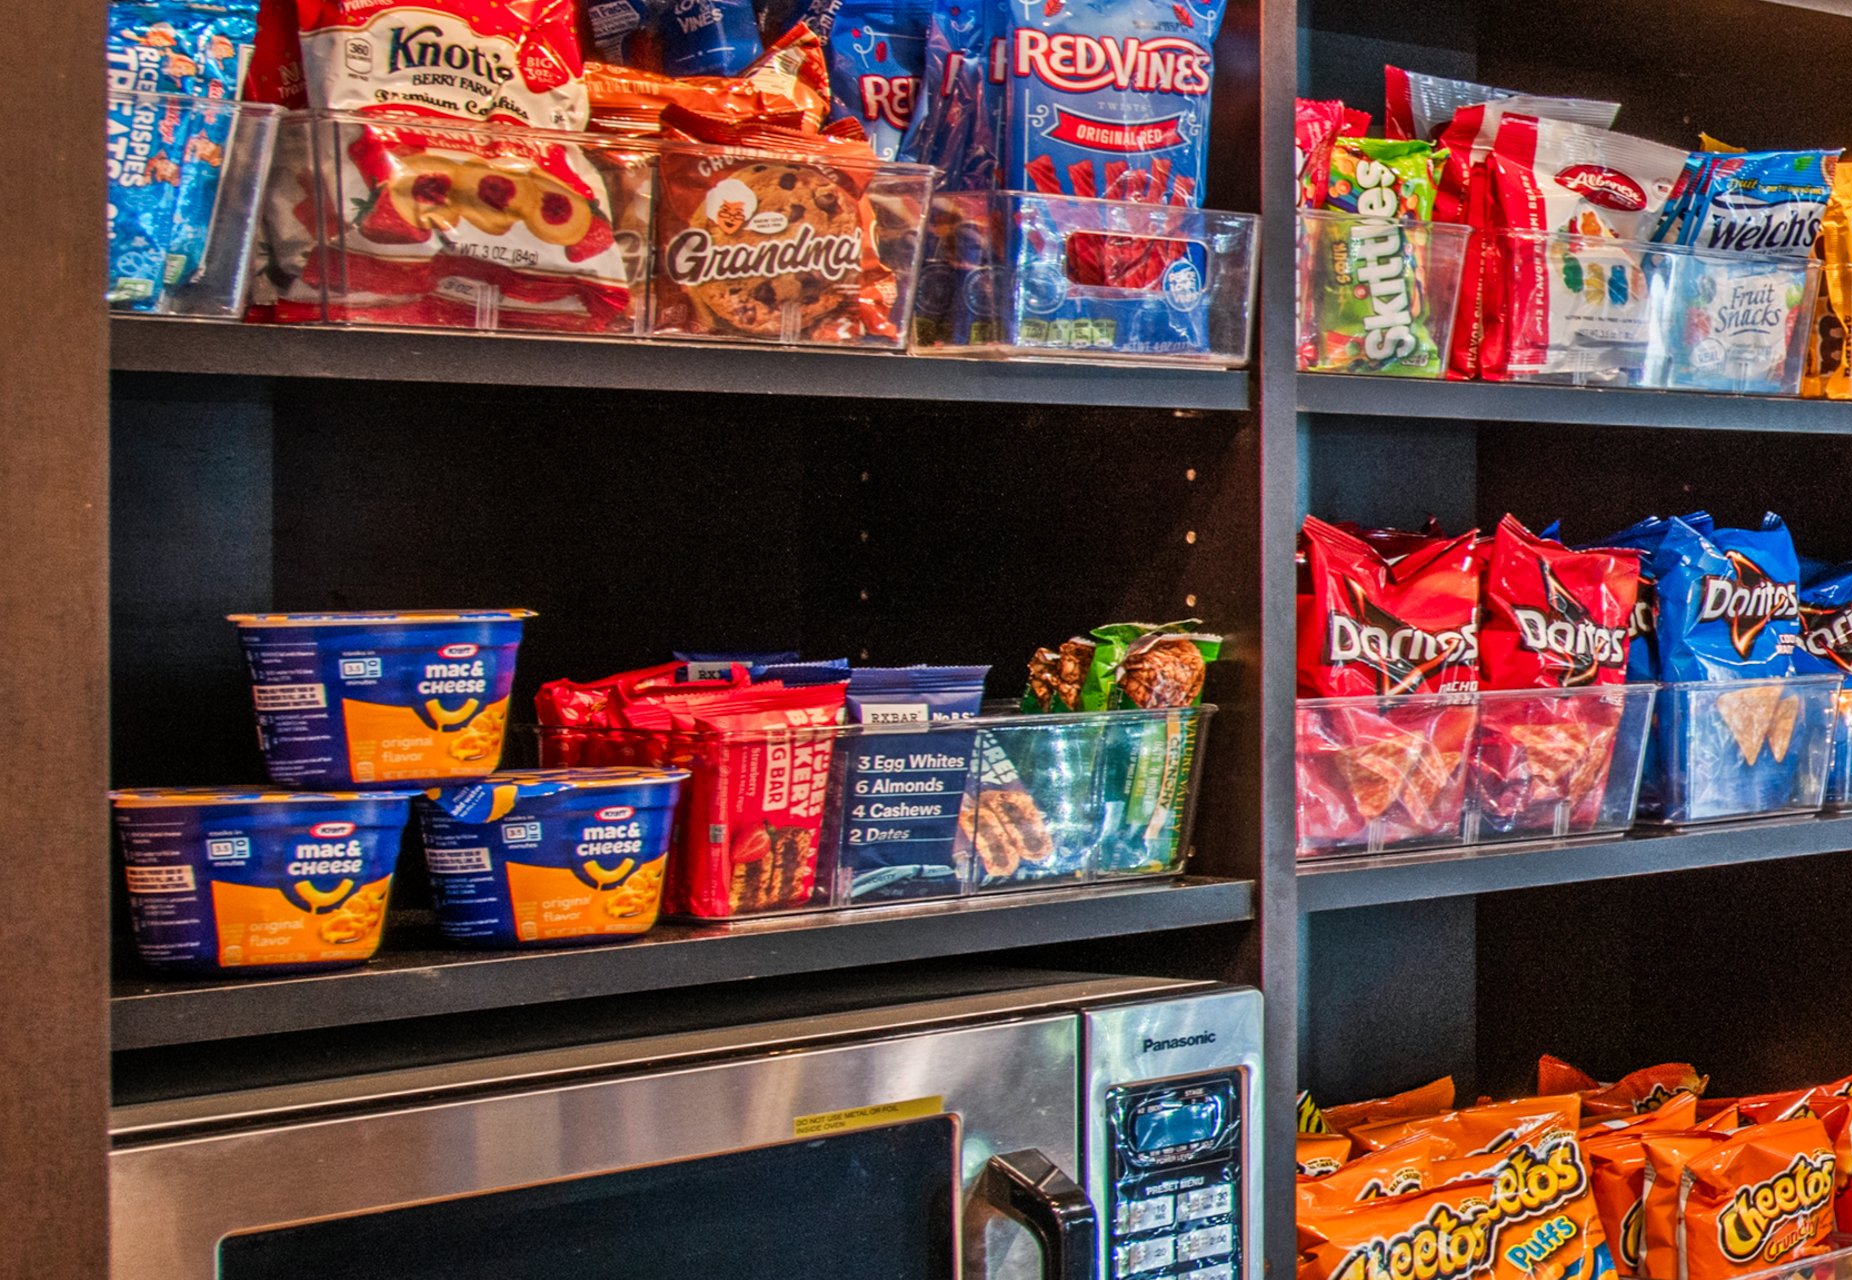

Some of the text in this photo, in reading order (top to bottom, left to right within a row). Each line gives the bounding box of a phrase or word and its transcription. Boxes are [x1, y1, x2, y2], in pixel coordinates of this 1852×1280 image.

[347, 40, 368, 58] 360
[525, 55, 554, 71] BIG
[412, 71, 495, 98] BERRY FARM
[119, 45, 161, 188] RICE KRISPIES
[1708, 209, 1824, 255] Welch's
[1351, 160, 1417, 360] Skittles
[1730, 282, 1775, 310] Fruit
[1714, 303, 1782, 333] Snacks
[1702, 577, 1798, 621] Doritos
[1515, 609, 1627, 665] Doritos
[870, 711, 919, 725] RXBAR
[381, 735, 434, 751] original
[858, 753, 965, 772] 3 Egg Whites
[765, 776, 787, 811] BAR
[855, 776, 944, 794] 6 Almonds
[852, 801, 942, 819] 4 Cashews
[849, 826, 910, 842] 2 Dates
[1142, 1029, 1217, 1054] Panasonic
[795, 1105, 899, 1128] DO NOT USE METAL OR FOIL
[795, 1122, 846, 1134] INSIDE OVEN
[1719, 1150, 1837, 1261] Cheetos
[1506, 1214, 1577, 1271] Puffs
[1763, 1221, 1817, 1264] Crunchy
